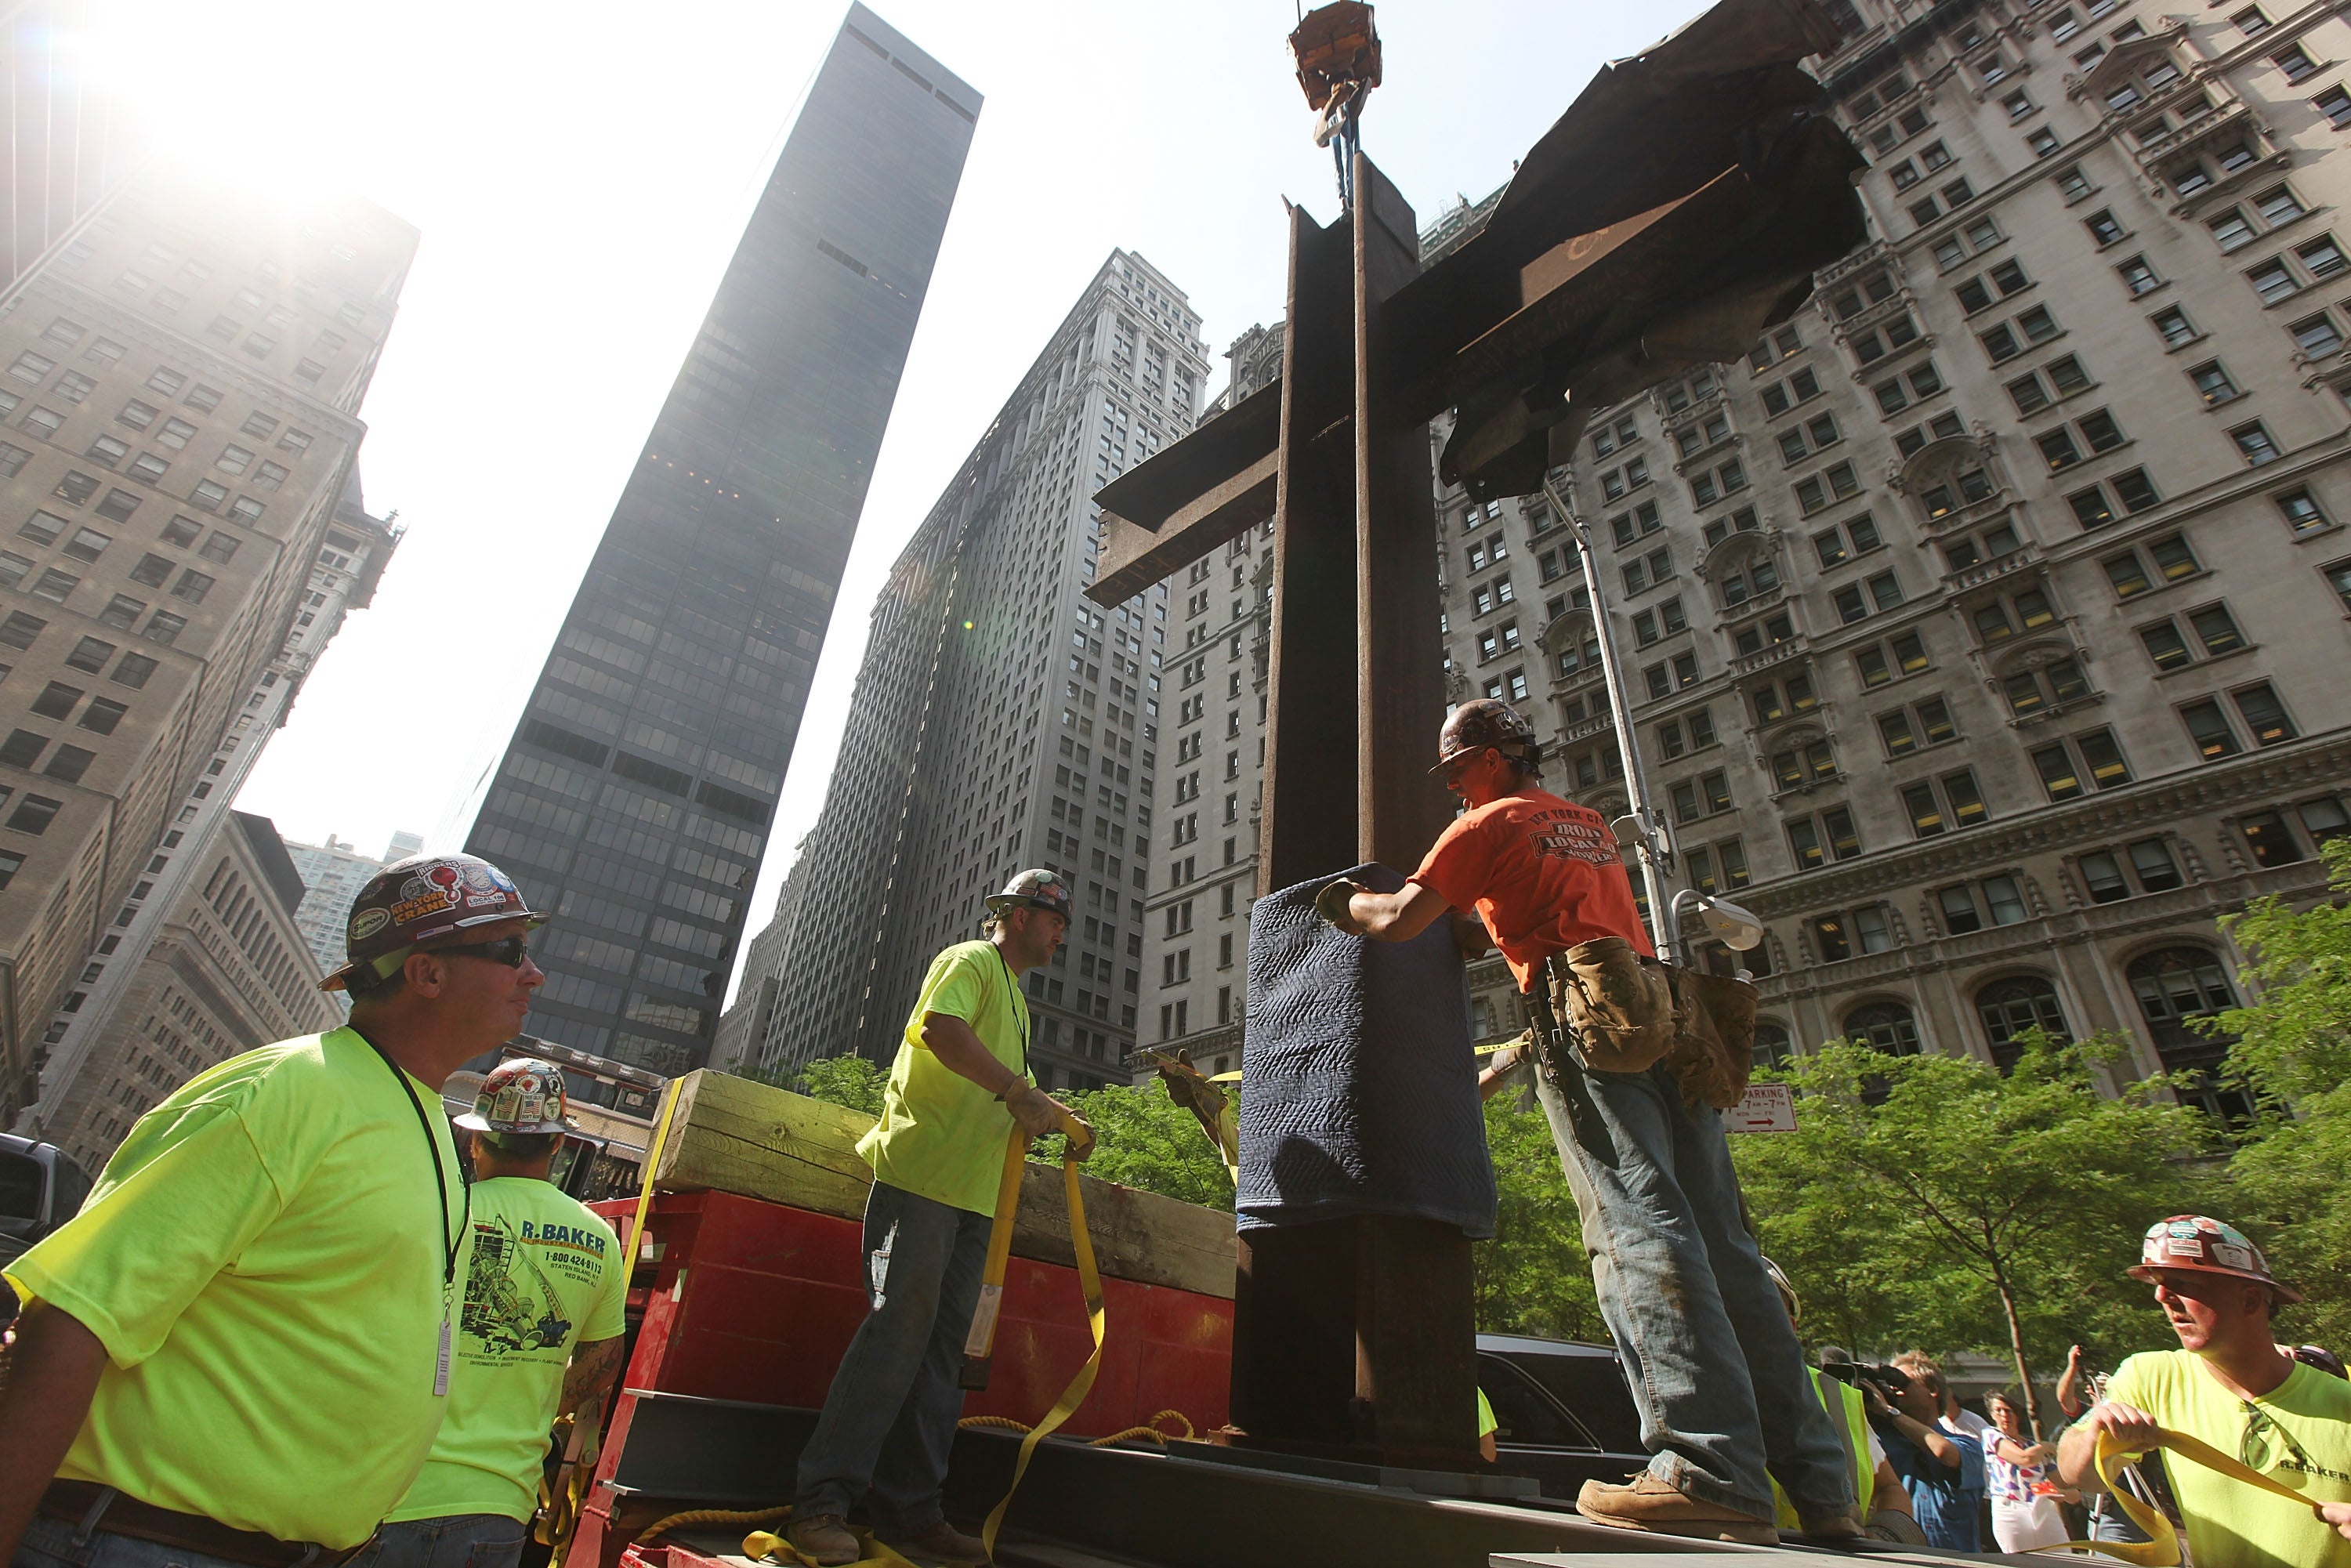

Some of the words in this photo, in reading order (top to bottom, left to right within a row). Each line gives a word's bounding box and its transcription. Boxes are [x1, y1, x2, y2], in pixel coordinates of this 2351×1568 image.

[1529, 810, 1550, 826] NEW
[1551, 809, 1581, 820] YORK
[1556, 824, 1602, 838] IRON
[1545, 836, 1599, 849] LOCAL
[419, 860, 459, 875] RIGGERS
[417, 890, 445, 905] YORK
[396, 900, 447, 923] CRANE
[521, 1220, 606, 1254] R.BAKER
[545, 1251, 569, 1263] 1-800
[571, 1255, 602, 1275] 424-8113
[550, 1262, 573, 1271] STATEN
[2280, 1460, 2349, 1482] R.BAKER
